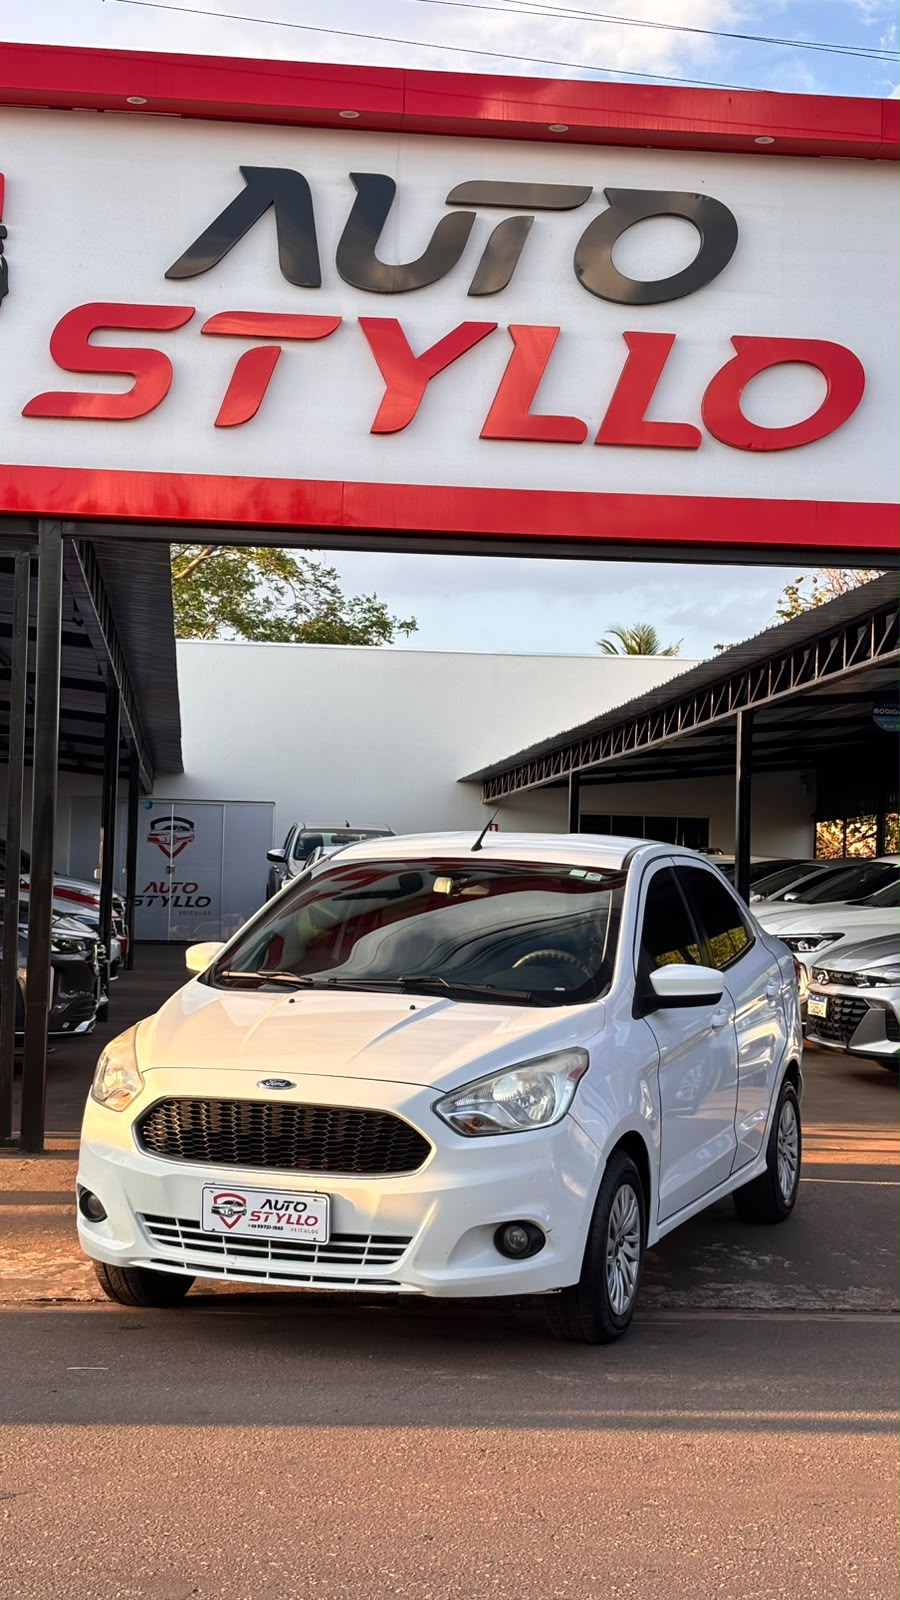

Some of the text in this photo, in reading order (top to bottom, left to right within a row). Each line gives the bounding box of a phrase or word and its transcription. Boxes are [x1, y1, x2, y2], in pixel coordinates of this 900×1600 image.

[165, 165, 739, 306] AUTO
[22, 302, 866, 452] STYLLO
[143, 881, 199, 894] AUTO
[134, 895, 212, 908] STYLLO
[260, 1199, 307, 1212] AUTO
[249, 1211, 318, 1227] STYLLO
